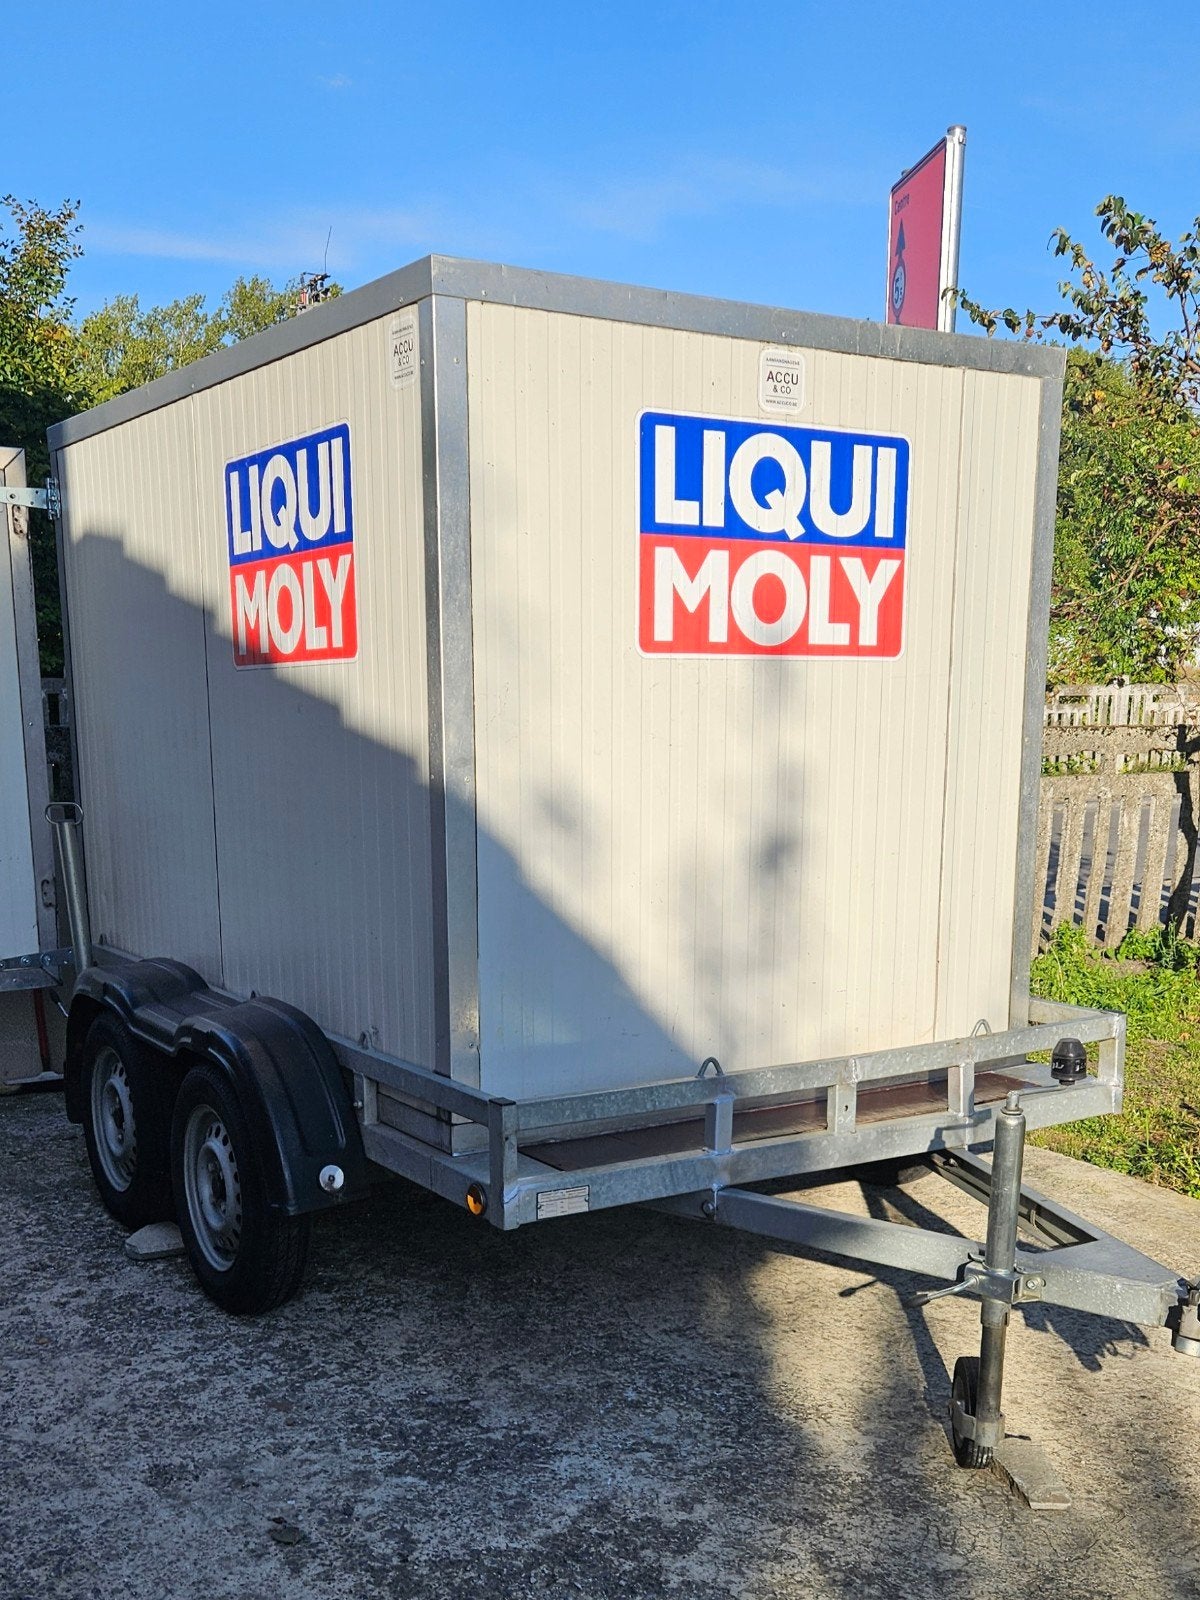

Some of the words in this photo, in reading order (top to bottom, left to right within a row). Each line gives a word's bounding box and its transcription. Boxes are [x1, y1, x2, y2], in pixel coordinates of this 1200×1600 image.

[393, 339, 413, 357] ACCU
[402, 355, 409, 365] CO
[766, 370, 799, 385] ACCU
[772, 385, 778, 393] &
[780, 385, 792, 394] CO
[230, 436, 346, 556] LIQUI
[654, 424, 897, 541] LIQUI
[235, 554, 352, 655] MOLY
[653, 546, 902, 646] MOLY
